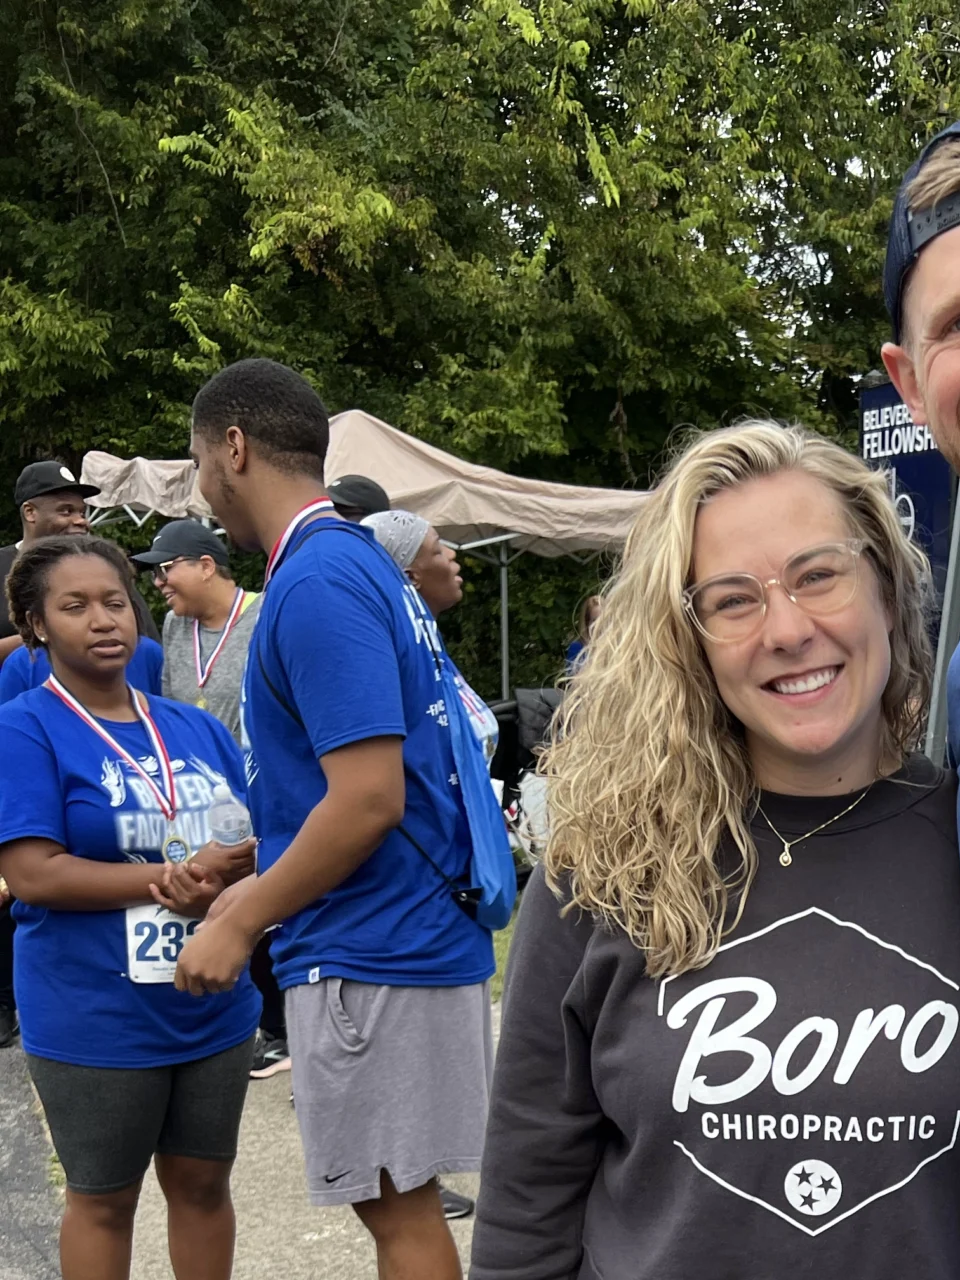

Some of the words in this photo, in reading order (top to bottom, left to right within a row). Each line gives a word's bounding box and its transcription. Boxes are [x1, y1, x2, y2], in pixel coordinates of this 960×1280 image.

[863, 404, 913, 431] BELIEVER
[863, 425, 938, 460] FELLOWSH
[667, 976, 960, 1112] Boro
[701, 1111, 936, 1142] CHIROPRACTIC
